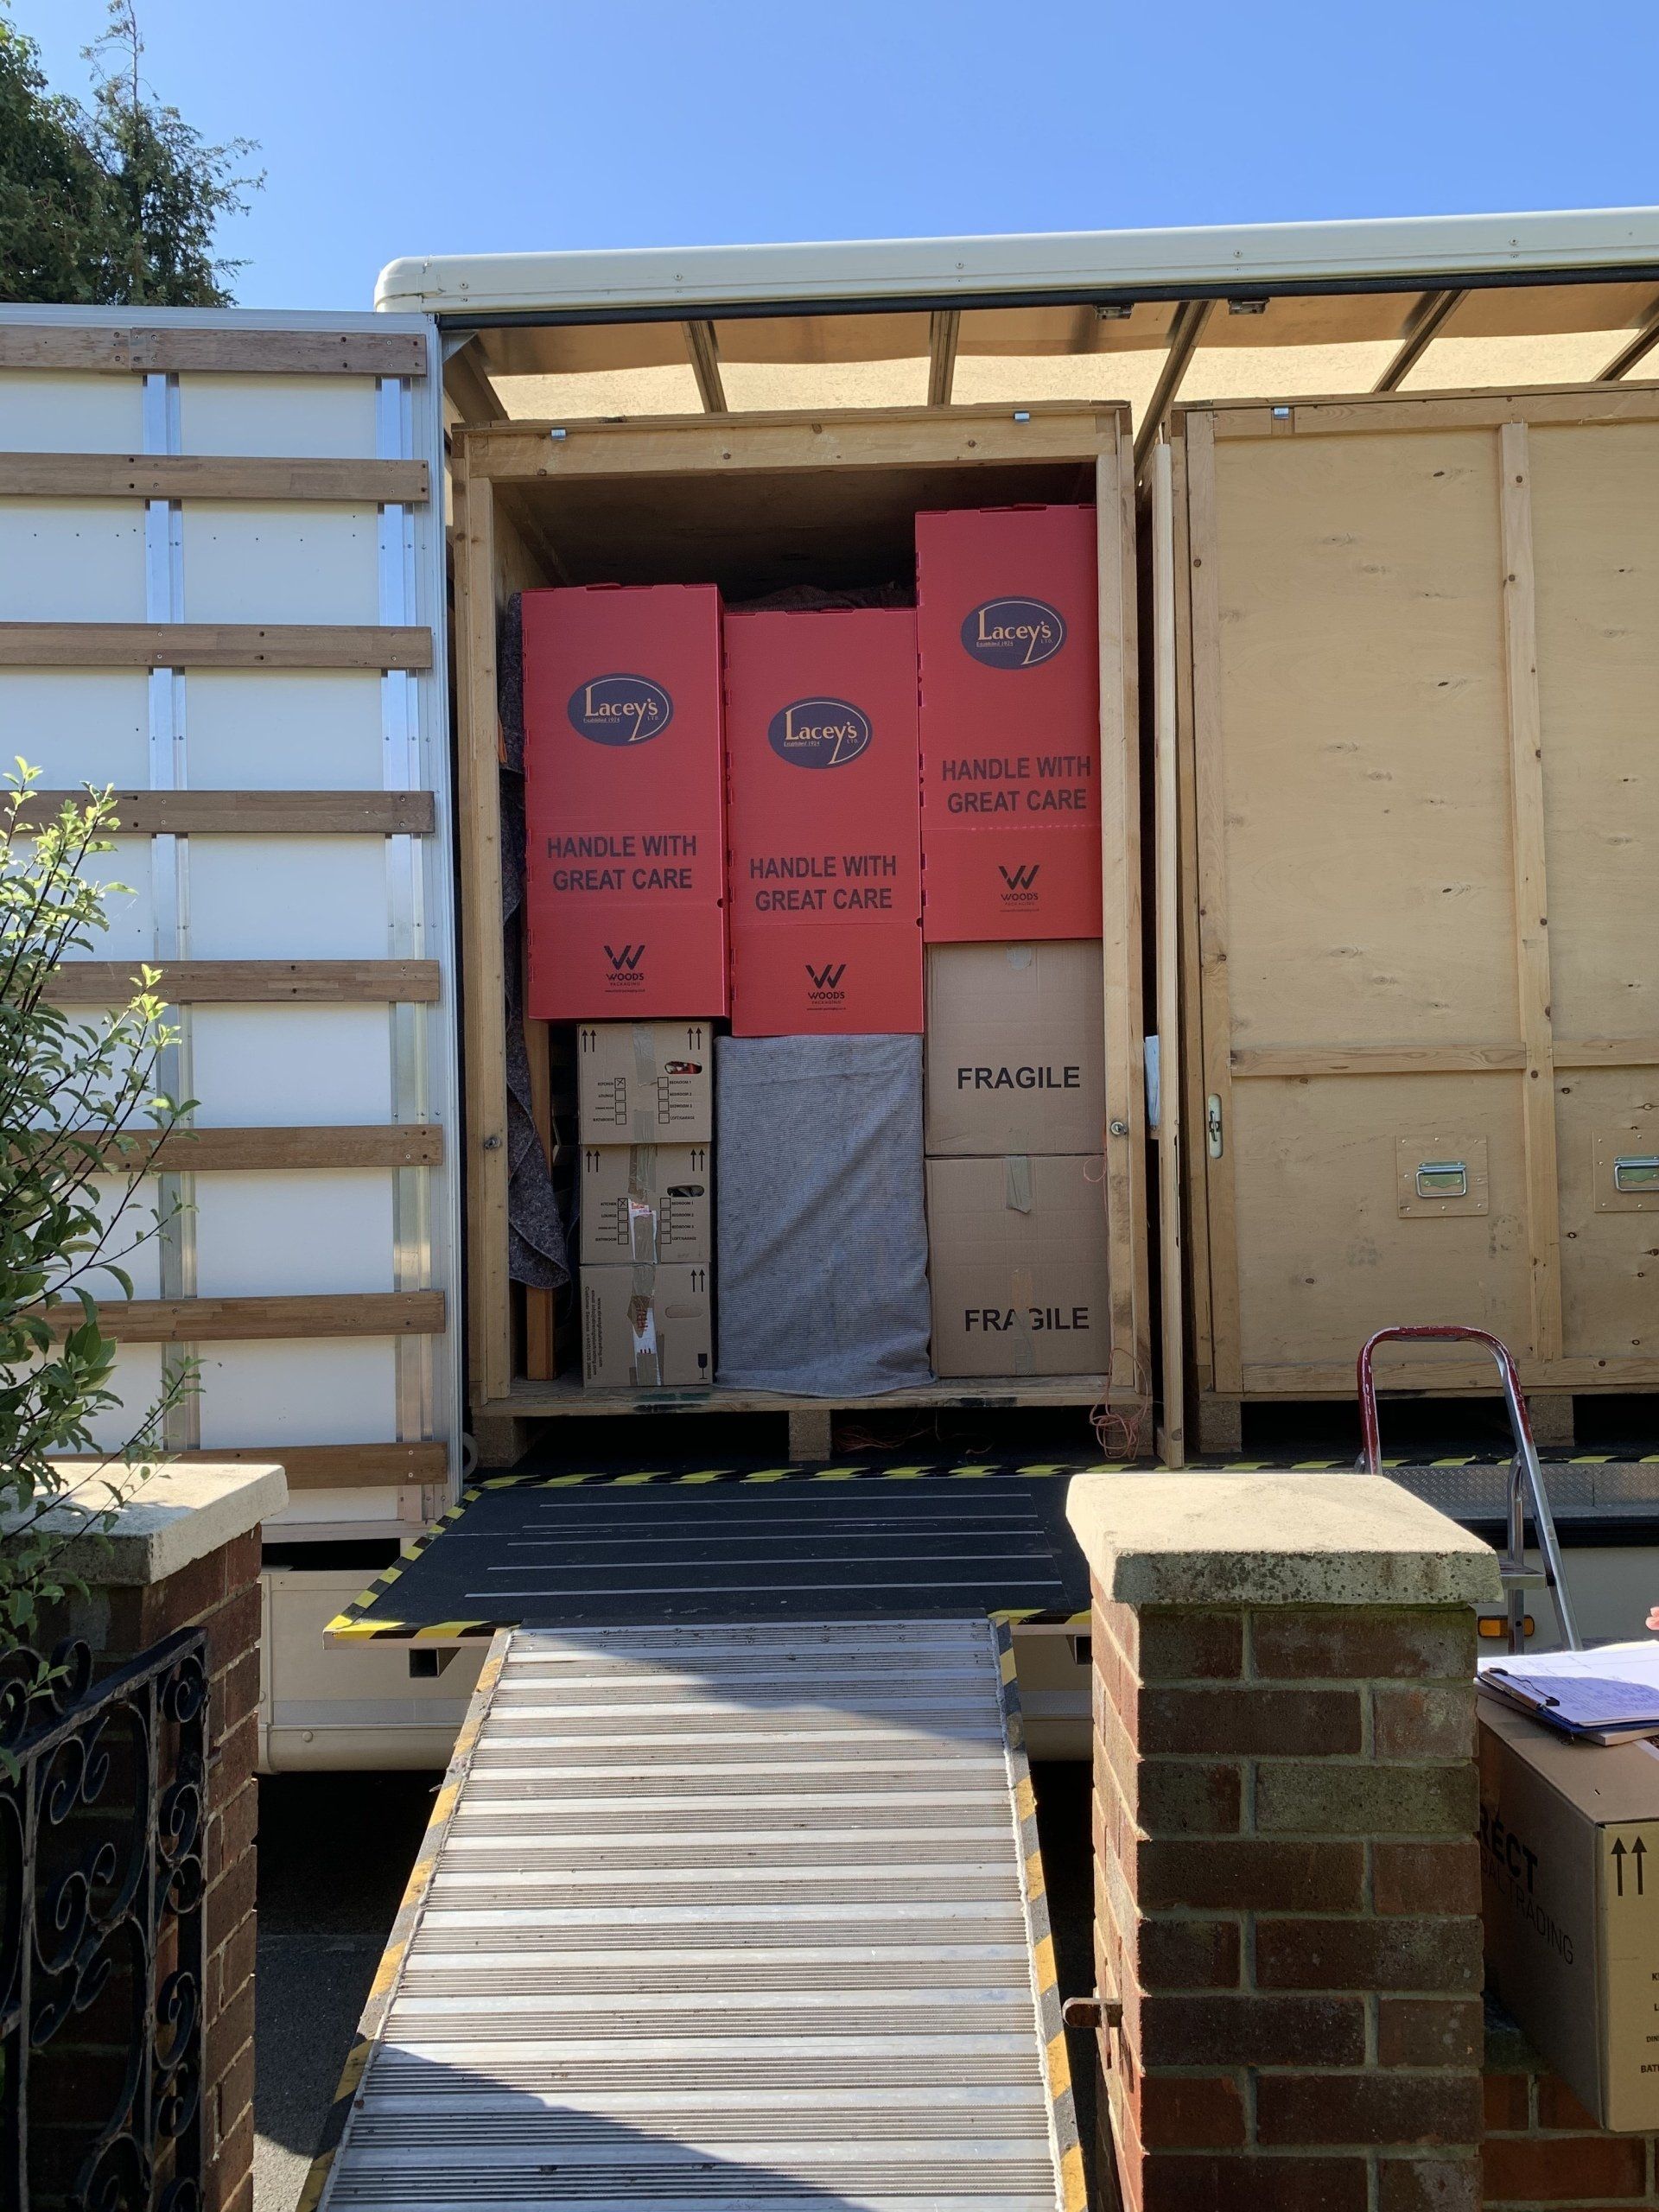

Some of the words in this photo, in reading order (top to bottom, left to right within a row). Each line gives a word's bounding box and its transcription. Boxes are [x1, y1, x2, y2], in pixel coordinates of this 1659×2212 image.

[977, 609, 1052, 664] Lacey's
[585, 686, 658, 741] Lacey's
[785, 710, 857, 765] Lacey's
[943, 758, 1030, 781] HANDLE
[1037, 756, 1090, 778] WITH
[948, 791, 1020, 813] GREAT
[1027, 789, 1086, 810] CARE
[548, 836, 636, 858] HANDLE
[642, 836, 696, 856] WITH
[750, 856, 836, 879] HANDLE
[842, 855, 896, 876] WITH
[553, 869, 625, 891] GREAT
[632, 868, 692, 889] CARE
[755, 889, 826, 911] GREAT
[833, 888, 893, 910] CARE
[958, 1066, 1080, 1089] FRAGILE
[1479, 1802, 1538, 1895] RECT
[1507, 1872, 1573, 1965] TRADING
